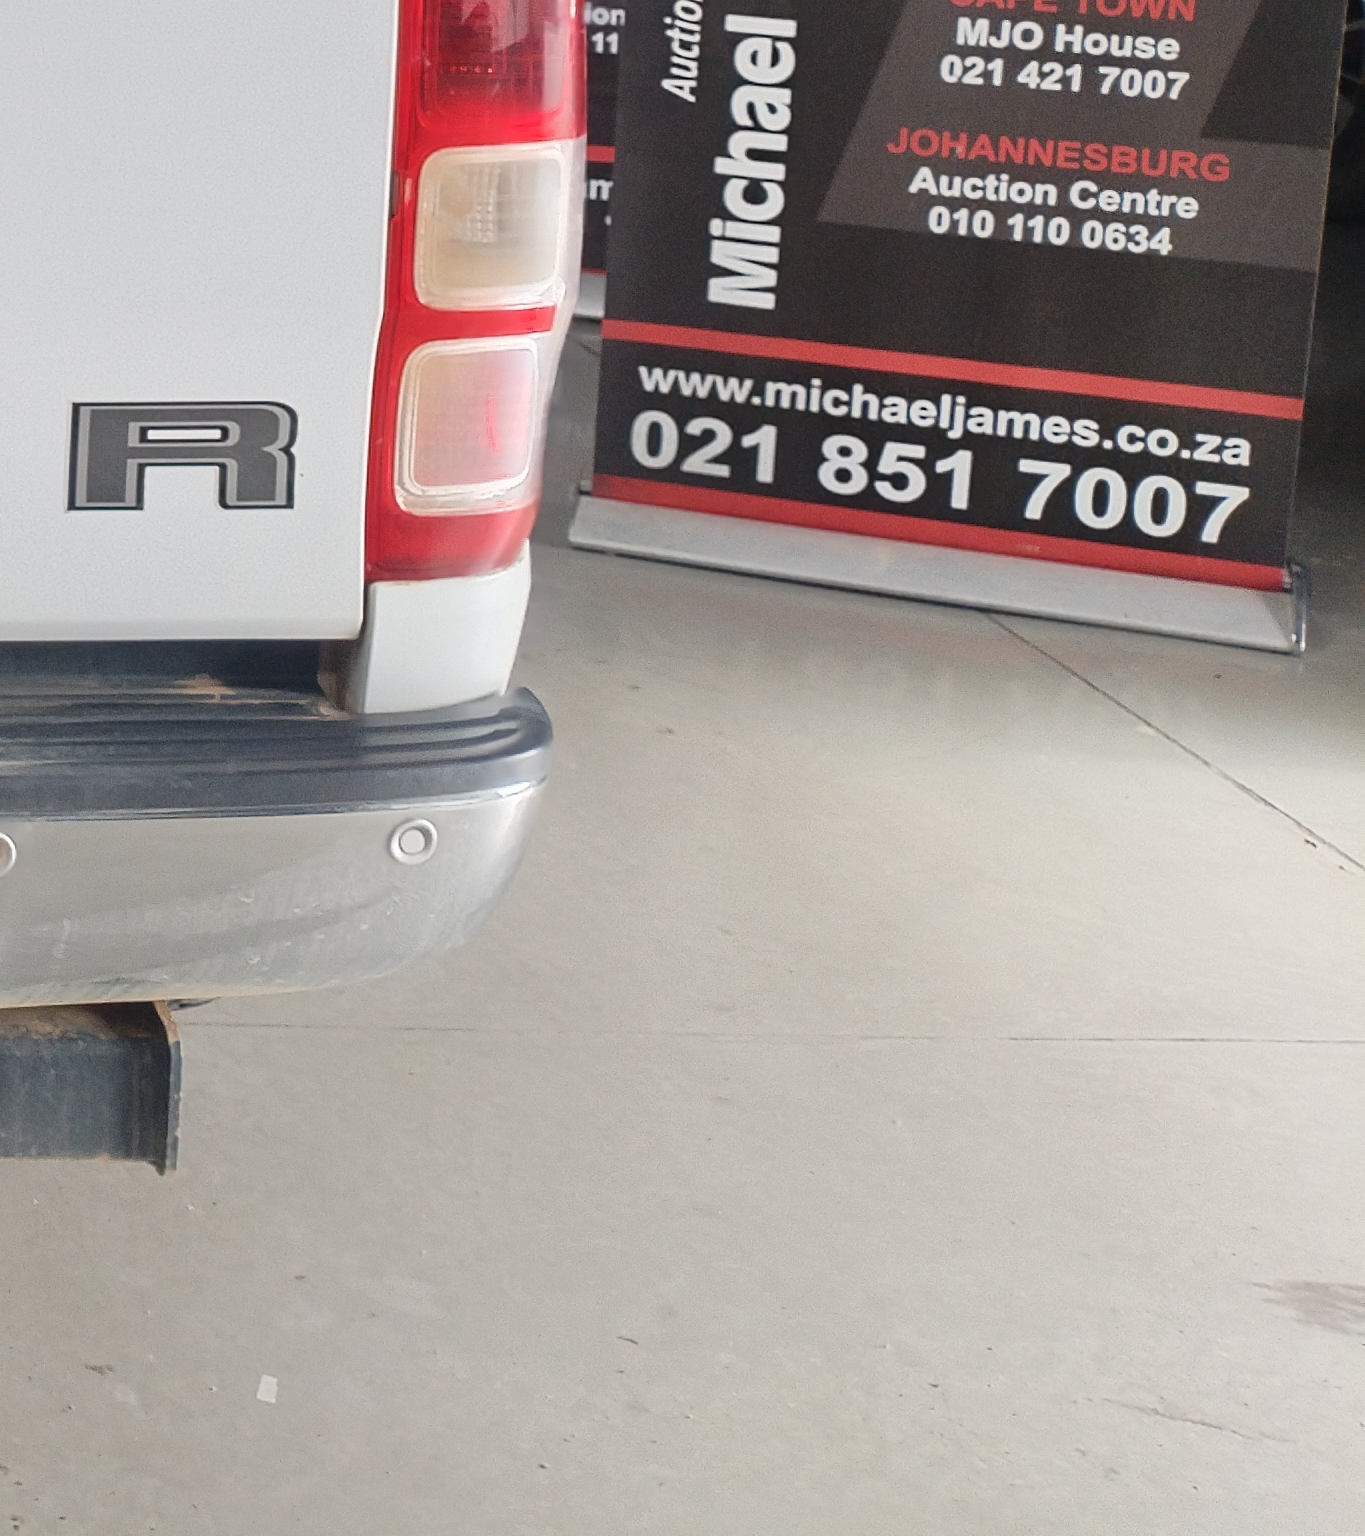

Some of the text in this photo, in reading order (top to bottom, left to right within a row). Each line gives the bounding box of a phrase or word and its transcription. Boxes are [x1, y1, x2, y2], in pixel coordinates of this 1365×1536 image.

[956, 17, 1180, 60] MJO House
[940, 55, 1190, 100] 021 421 7007
[708, 14, 797, 309] Michael
[888, 128, 1230, 182] JOHANNESBURG
[908, 167, 1199, 219] Auction Centre
[928, 206, 1172, 255] 010 110 0634
[638, 364, 1253, 467] www.michaeljames.co.za
[631, 410, 1250, 543] 021 851 7007
